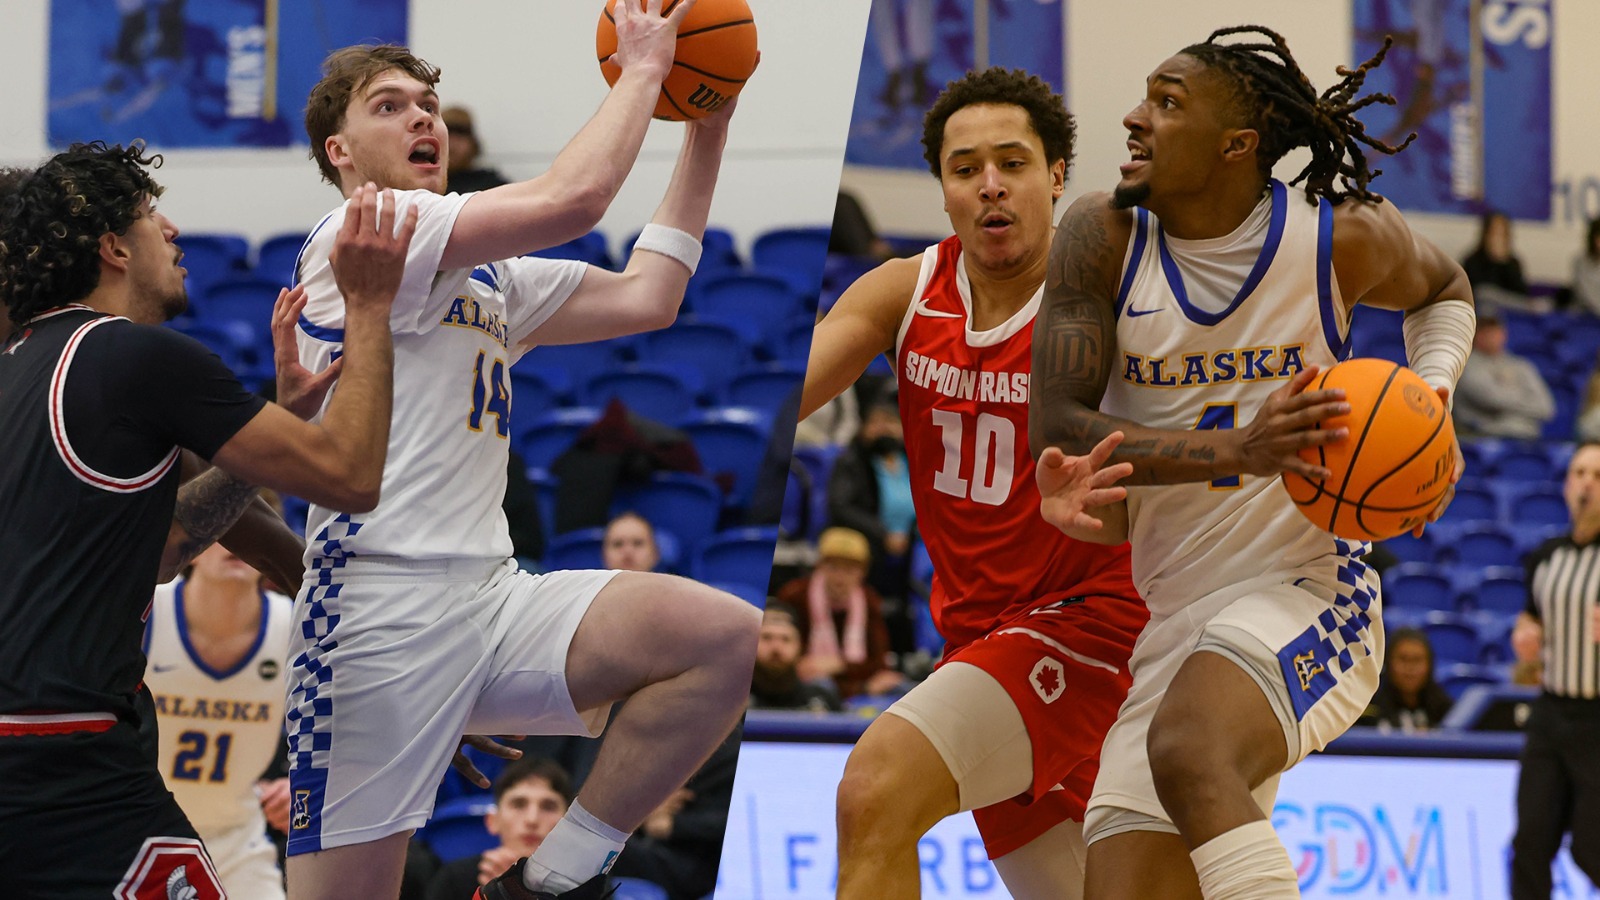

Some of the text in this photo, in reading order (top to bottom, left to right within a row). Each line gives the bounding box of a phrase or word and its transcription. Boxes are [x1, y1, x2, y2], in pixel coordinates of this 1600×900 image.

[467, 348, 510, 439] 14
[905, 350, 977, 401] SIMON
[975, 371, 1031, 404] RAS
[1122, 343, 1308, 389] ALASKA
[931, 408, 1016, 506] 10
[154, 693, 272, 723] ALASKA
[170, 728, 233, 784] 21
